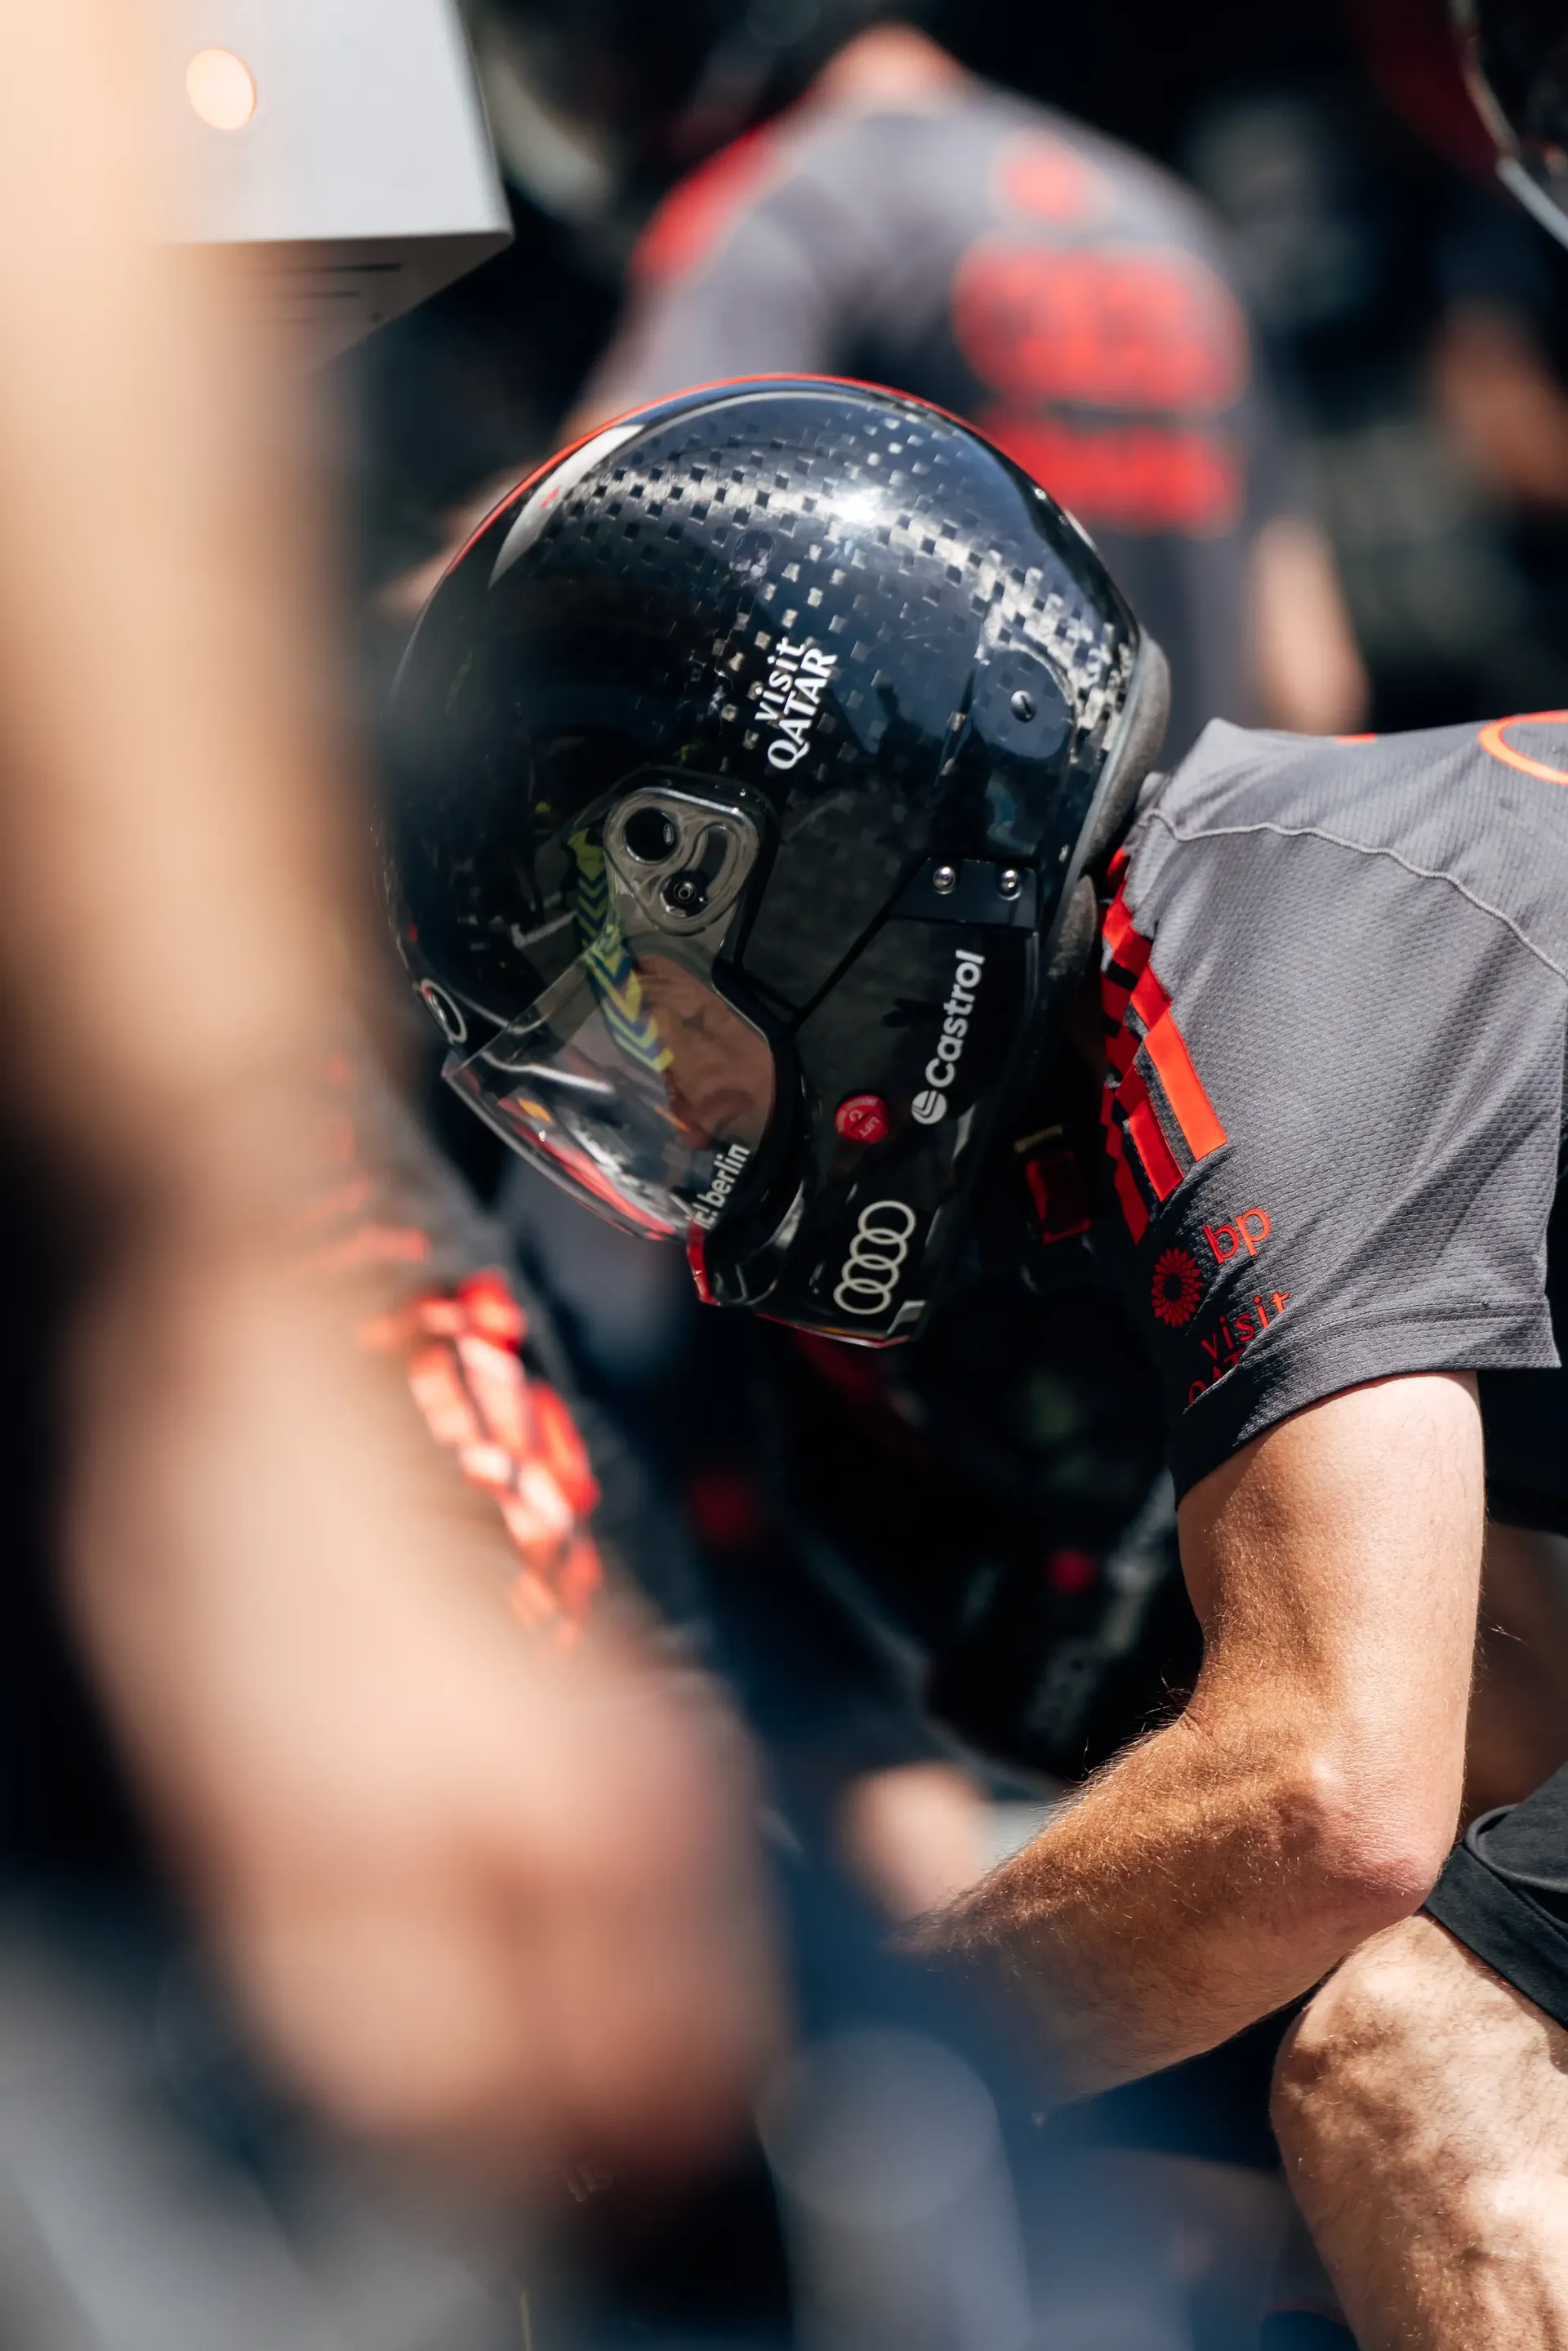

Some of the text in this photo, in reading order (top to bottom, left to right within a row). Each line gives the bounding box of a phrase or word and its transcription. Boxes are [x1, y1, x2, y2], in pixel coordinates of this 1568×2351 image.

[755, 636, 805, 720] visit
[768, 648, 838, 770] QATAR
[925, 949, 985, 1088] Castrol
[696, 1143, 751, 1208] berlin
[1203, 1208, 1272, 1265] bp
[1200, 1291, 1290, 1360] visit
